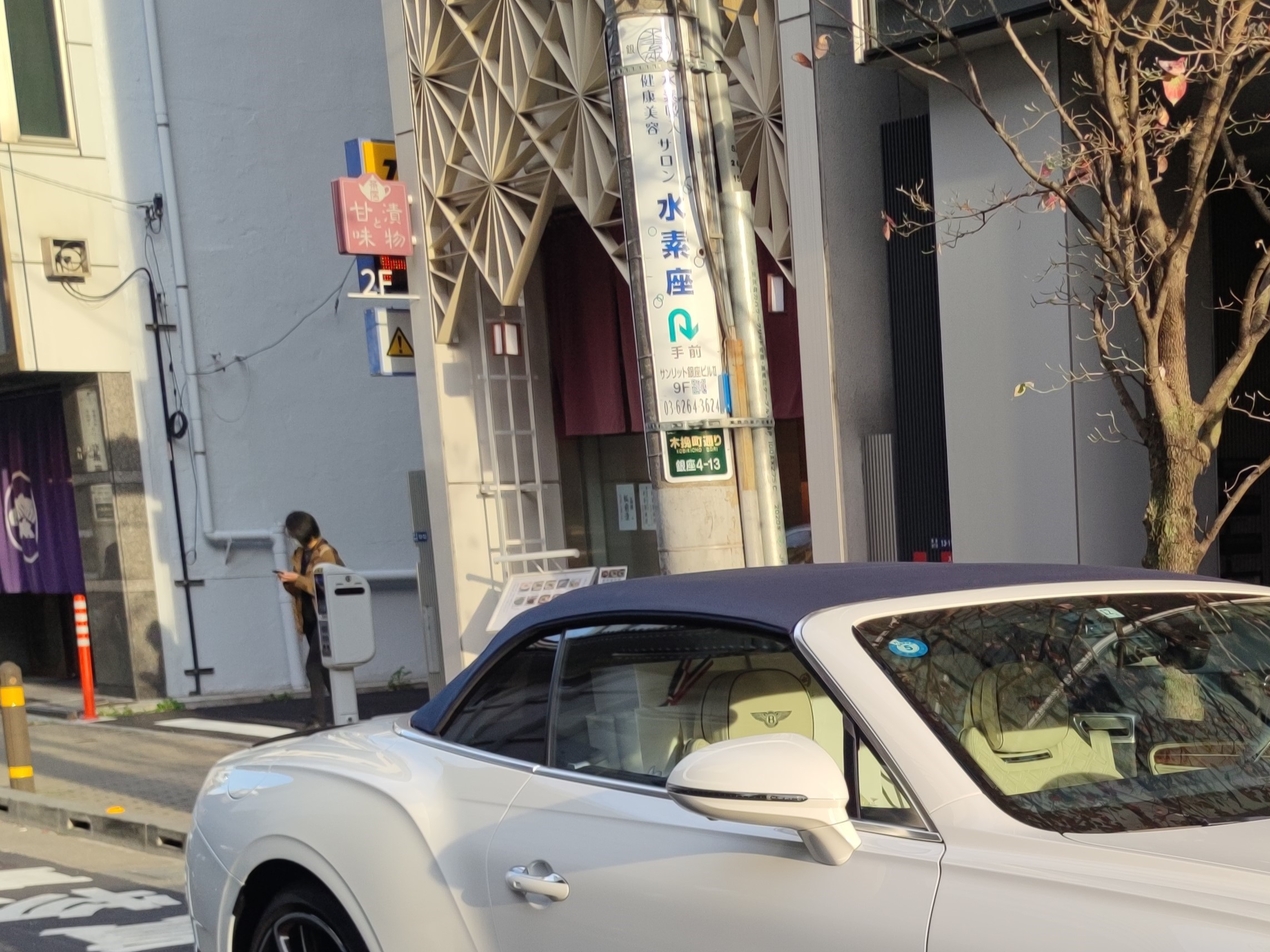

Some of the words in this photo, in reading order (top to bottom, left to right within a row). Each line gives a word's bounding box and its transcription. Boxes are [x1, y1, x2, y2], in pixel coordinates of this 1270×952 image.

[640, 74, 660, 136] 健康美容
[657, 138, 676, 184] サロン
[350, 201, 376, 247] 甘味
[382, 202, 405, 249] 漬物
[657, 193, 694, 295] 水素座
[361, 268, 393, 295] 2F
[671, 345, 702, 360] 手前
[673, 381, 690, 394] 9F
[669, 434, 722, 449] 木挽町通り
[675, 457, 721, 473] 銀座4-13
